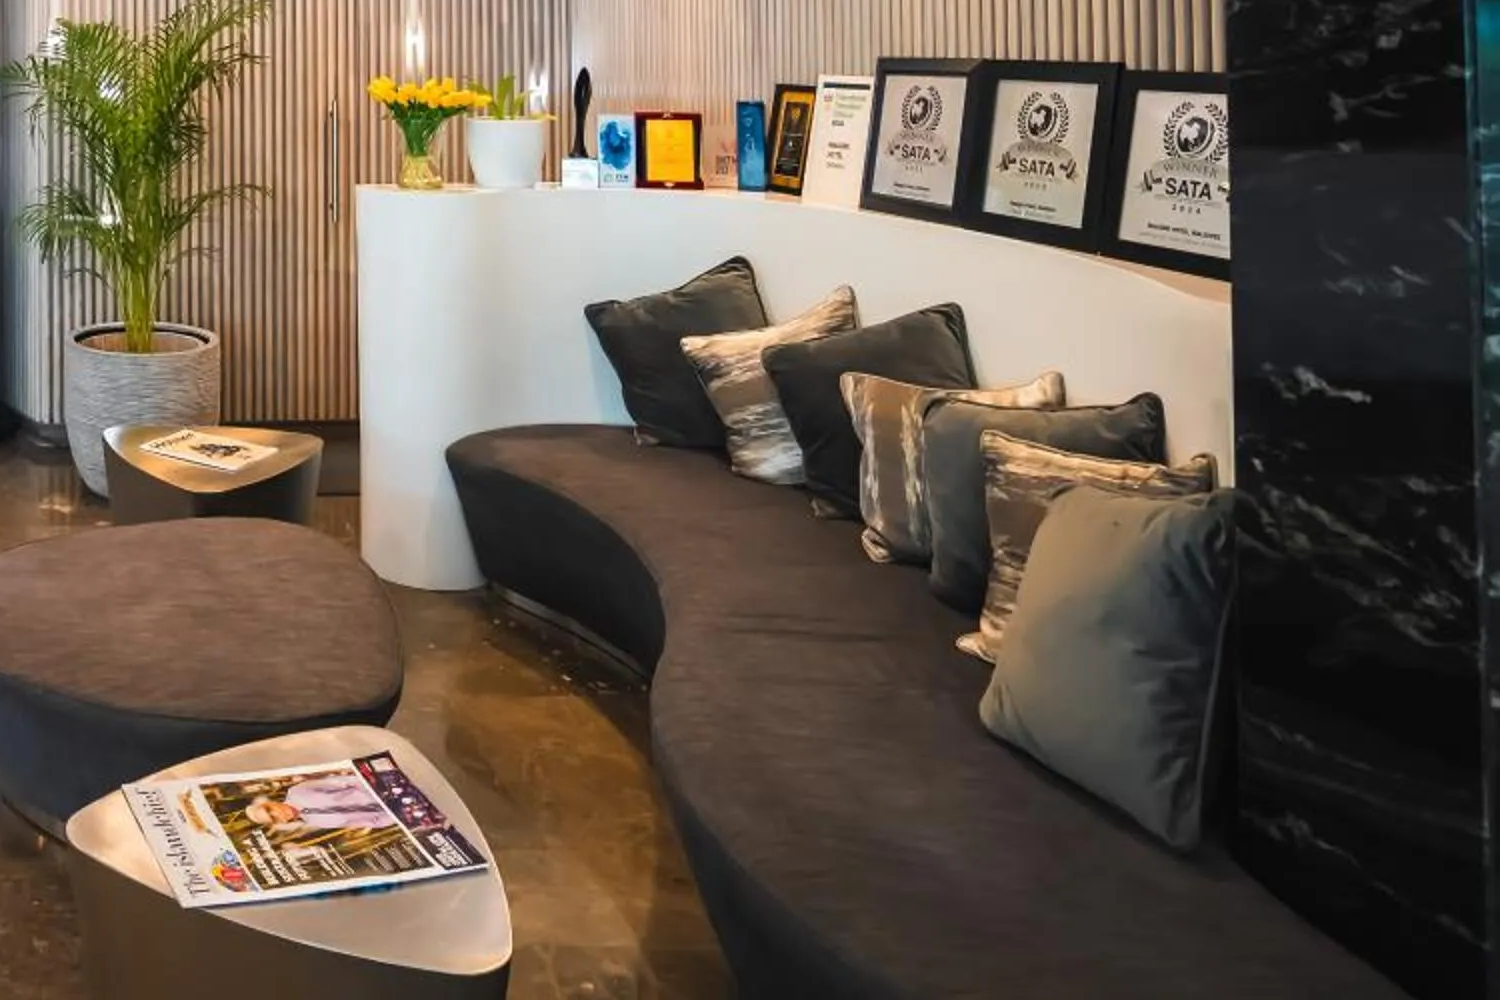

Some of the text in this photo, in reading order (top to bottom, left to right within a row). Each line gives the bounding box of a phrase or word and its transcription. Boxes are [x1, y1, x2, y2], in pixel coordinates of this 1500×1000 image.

[901, 144, 931, 161] SATA
[1019, 158, 1055, 177] SATA
[1165, 177, 1212, 201] SATA
